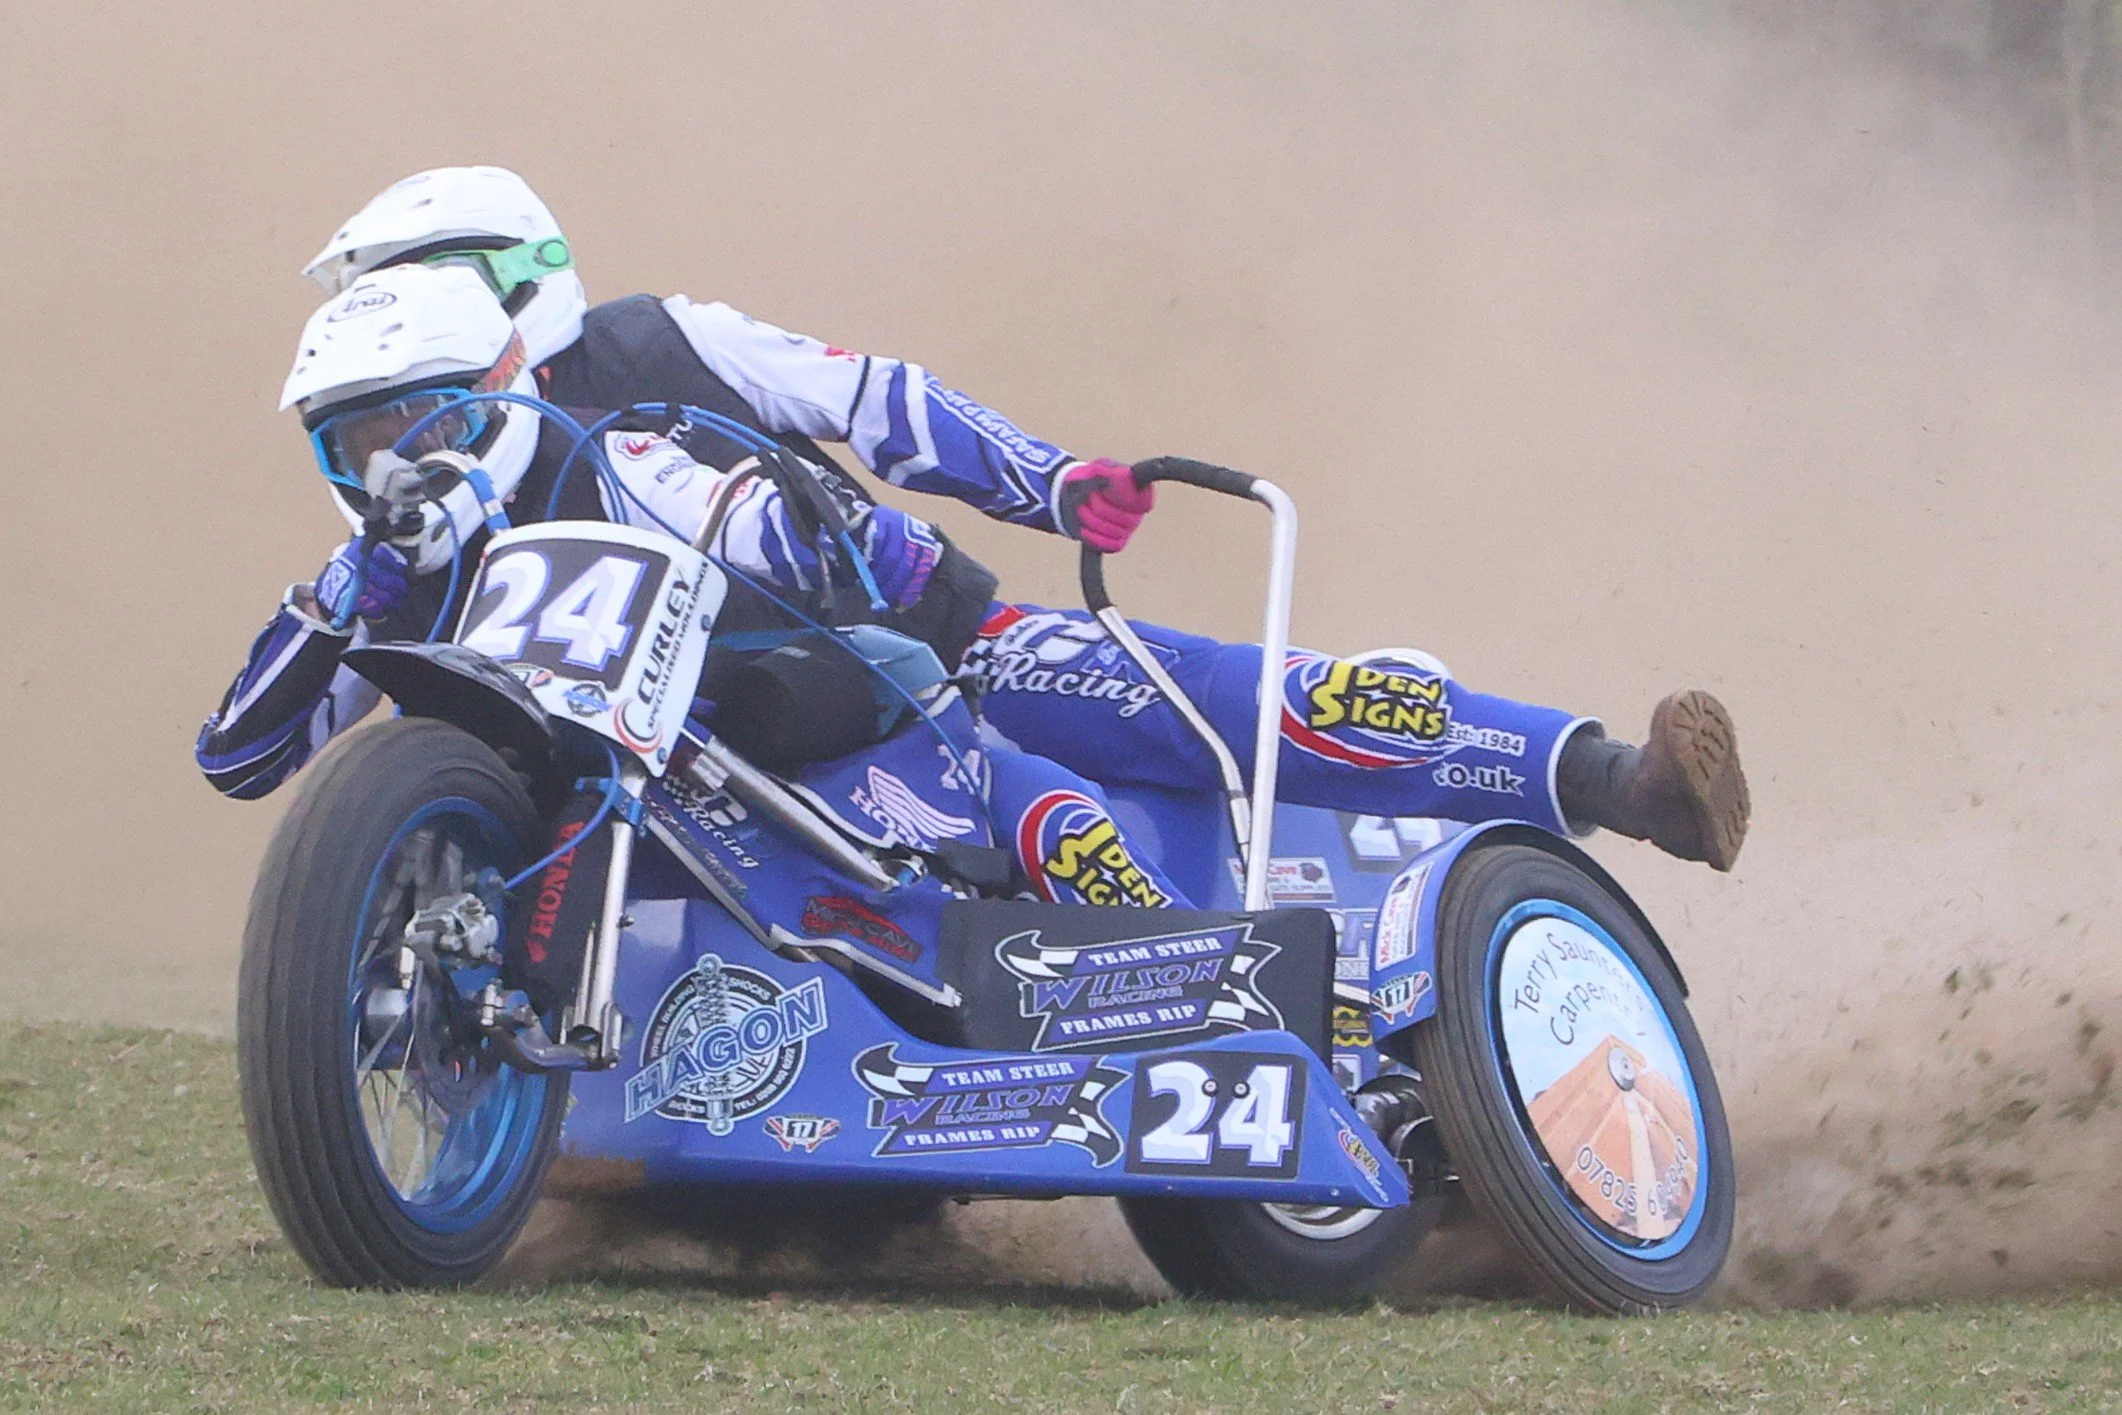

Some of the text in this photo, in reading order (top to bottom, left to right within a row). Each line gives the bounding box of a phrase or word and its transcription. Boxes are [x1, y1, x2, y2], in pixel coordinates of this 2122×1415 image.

[458, 551, 649, 672] 24
[637, 566, 692, 706] CURLEY
[991, 651, 1161, 718] Racing
[1479, 731, 1521, 753] 1984
[683, 806, 760, 868] Racing
[1087, 937, 1223, 968] TEAM STEER
[1033, 957, 1224, 1013] WILSON
[1087, 985, 1184, 1009] RACING
[1514, 950, 1558, 1014] Terry
[1060, 1003, 1198, 1036] FRAMES RIP
[625, 977, 828, 1123] HAGON
[941, 1062, 1076, 1087] TEAM STEER
[791, 1121, 813, 1138] 17
[881, 1084, 1076, 1126] WILSON
[1140, 1060, 1298, 1167] 24
[903, 1126, 1042, 1147] FRAMES RIP
